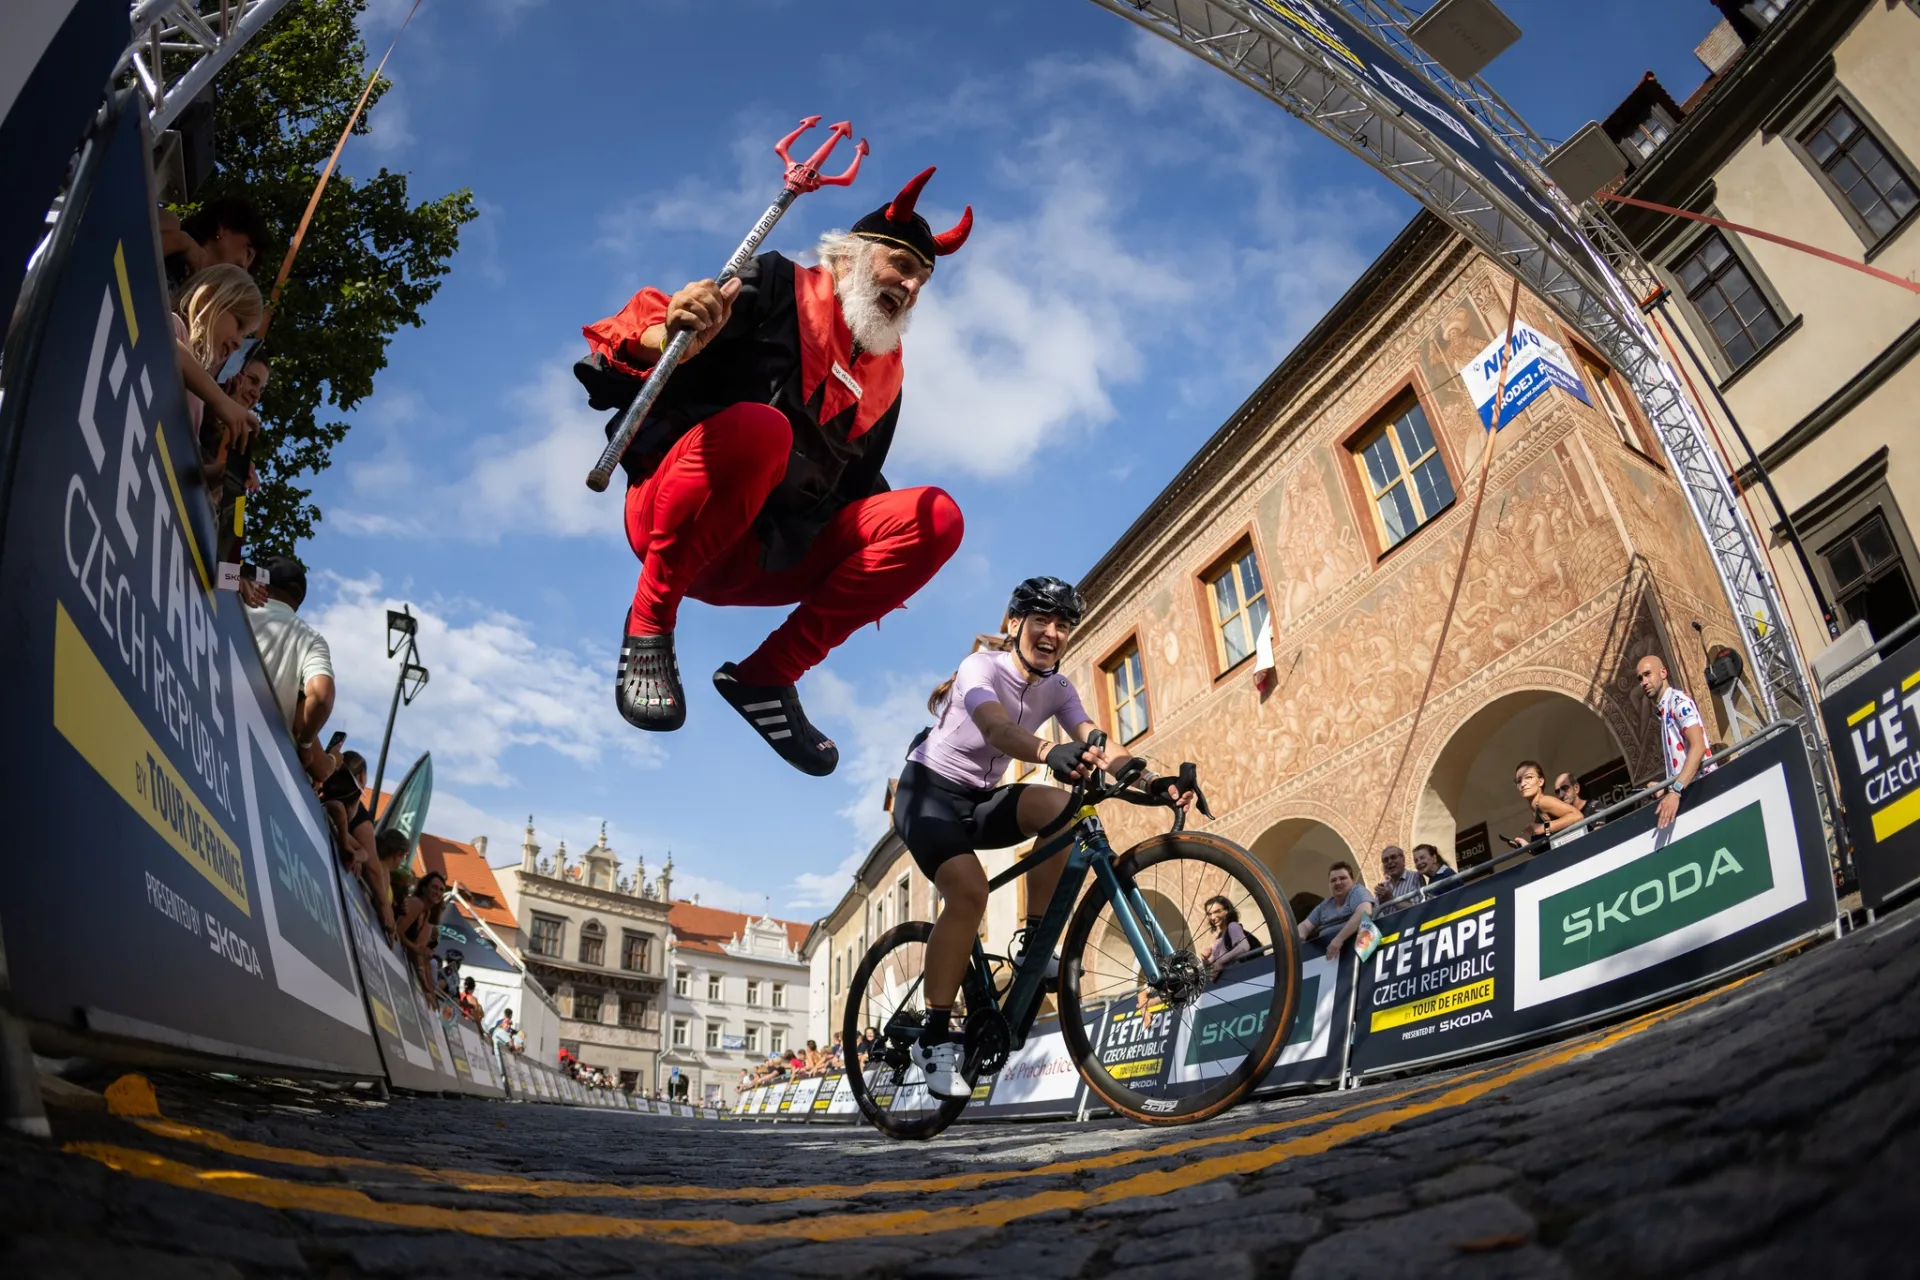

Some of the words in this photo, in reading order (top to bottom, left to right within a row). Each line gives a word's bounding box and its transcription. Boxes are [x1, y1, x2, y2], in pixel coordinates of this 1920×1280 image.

[727, 247, 749, 269] Tour
[746, 235, 759, 248] de
[753, 206, 780, 236] France
[224, 573, 241, 582] SKO
[64, 473, 147, 693] CZECH
[153, 635, 236, 822] REPUBLIC
[135, 761, 148, 801] BY
[146, 750, 188, 844] TOUR
[186, 801, 207, 862] DE
[203, 824, 247, 901] FRANCE
[144, 870, 192, 932] PRESENTED
[189, 905, 202, 938] BY
[1562, 846, 1744, 945] SKODA
[1373, 976, 1417, 1006] CZECH
[1420, 951, 1496, 993] REPUBLIC
[1412, 999, 1437, 1017] TOUR
[1438, 995, 1451, 1010] DE
[1451, 983, 1490, 1006] FRANCE
[1201, 1008, 1299, 1046] SKO
[1401, 1027, 1428, 1041] PRESENTED
[1428, 1025, 1436, 1034] BY
[1439, 1009, 1493, 1033] SKODA
[1016, 1056, 1073, 1080] Prachatice
[1103, 1047, 1127, 1064] CZECH
[1126, 1039, 1168, 1060] REPUBLIC
